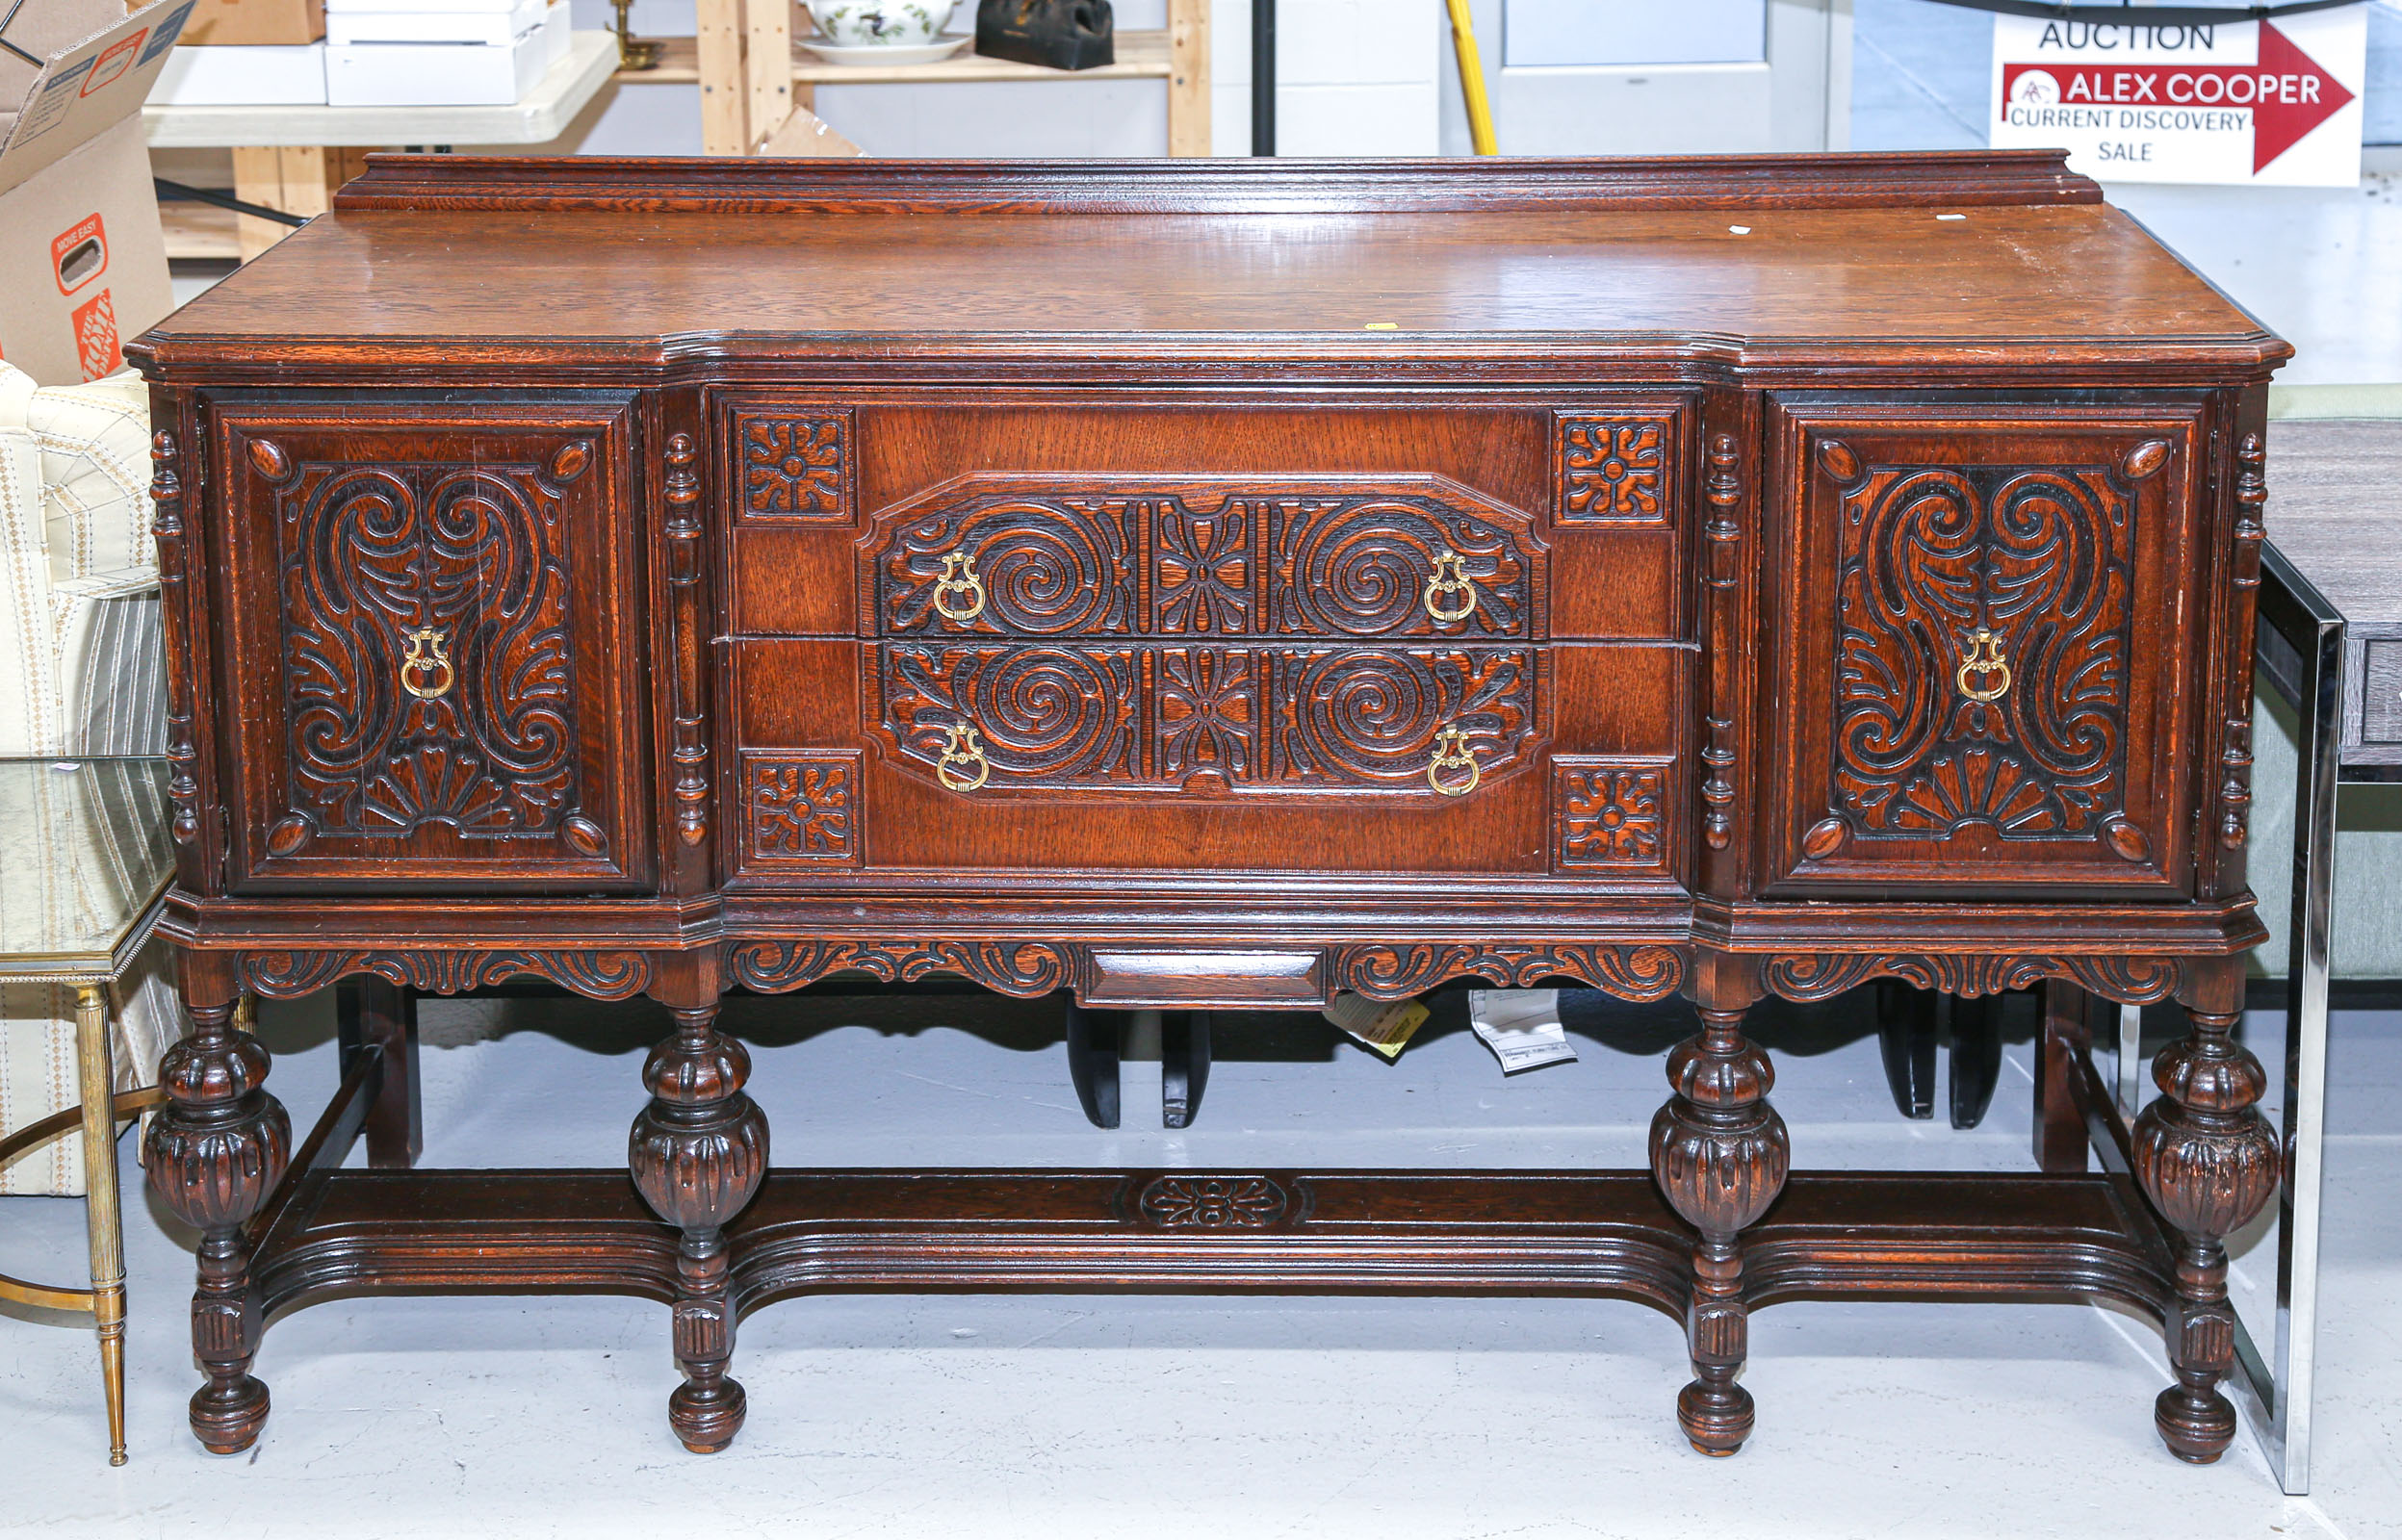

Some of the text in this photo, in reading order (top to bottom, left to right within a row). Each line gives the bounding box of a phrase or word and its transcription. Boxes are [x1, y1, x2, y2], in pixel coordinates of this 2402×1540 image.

[2039, 21, 2214, 50] AUCTION
[2066, 72, 2321, 104] ALEX COOPER
[2010, 107, 2248, 131] CURRENT DISCOVERY
[2098, 141, 2154, 162] SALE
[57, 218, 96, 253] MOVE EASY
